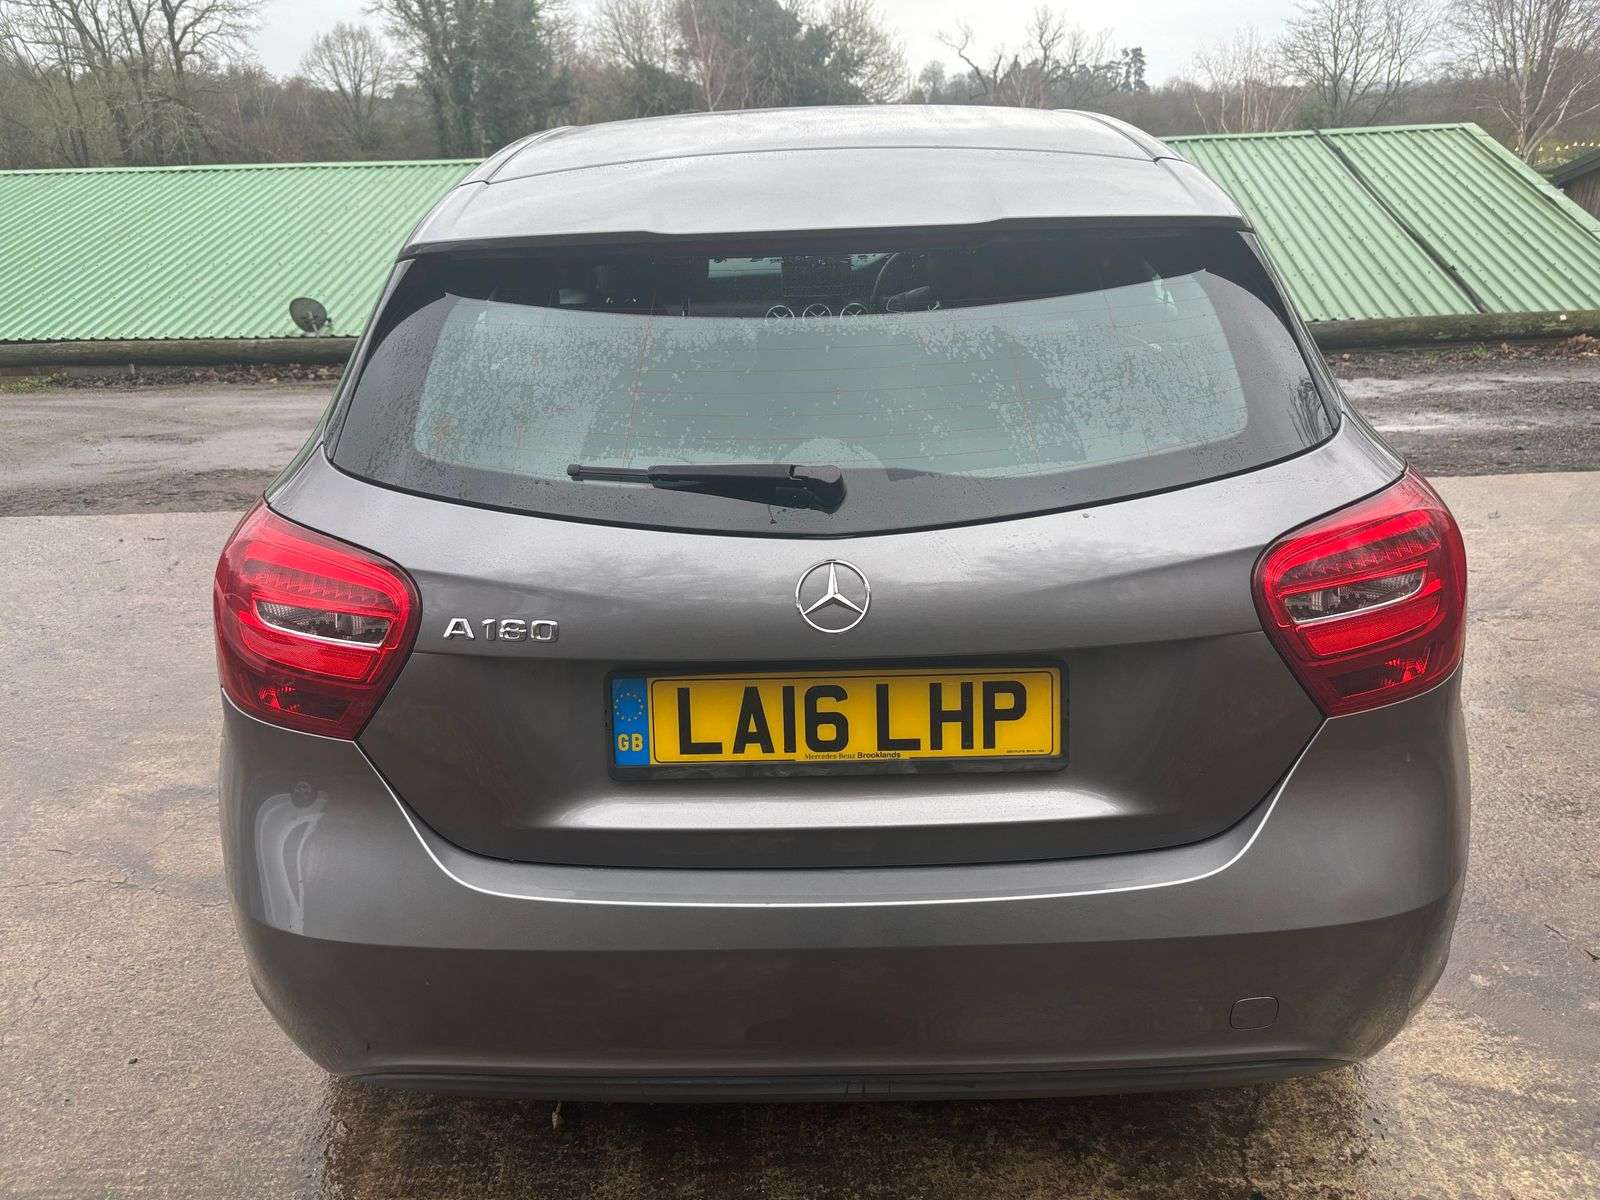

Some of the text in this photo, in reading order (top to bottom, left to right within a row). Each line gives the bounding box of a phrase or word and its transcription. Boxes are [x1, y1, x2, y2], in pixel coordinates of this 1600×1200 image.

[677, 681, 1027, 754] LA16 LHP
[618, 733, 644, 752] GB
[857, 751, 901, 759] Brooklands
